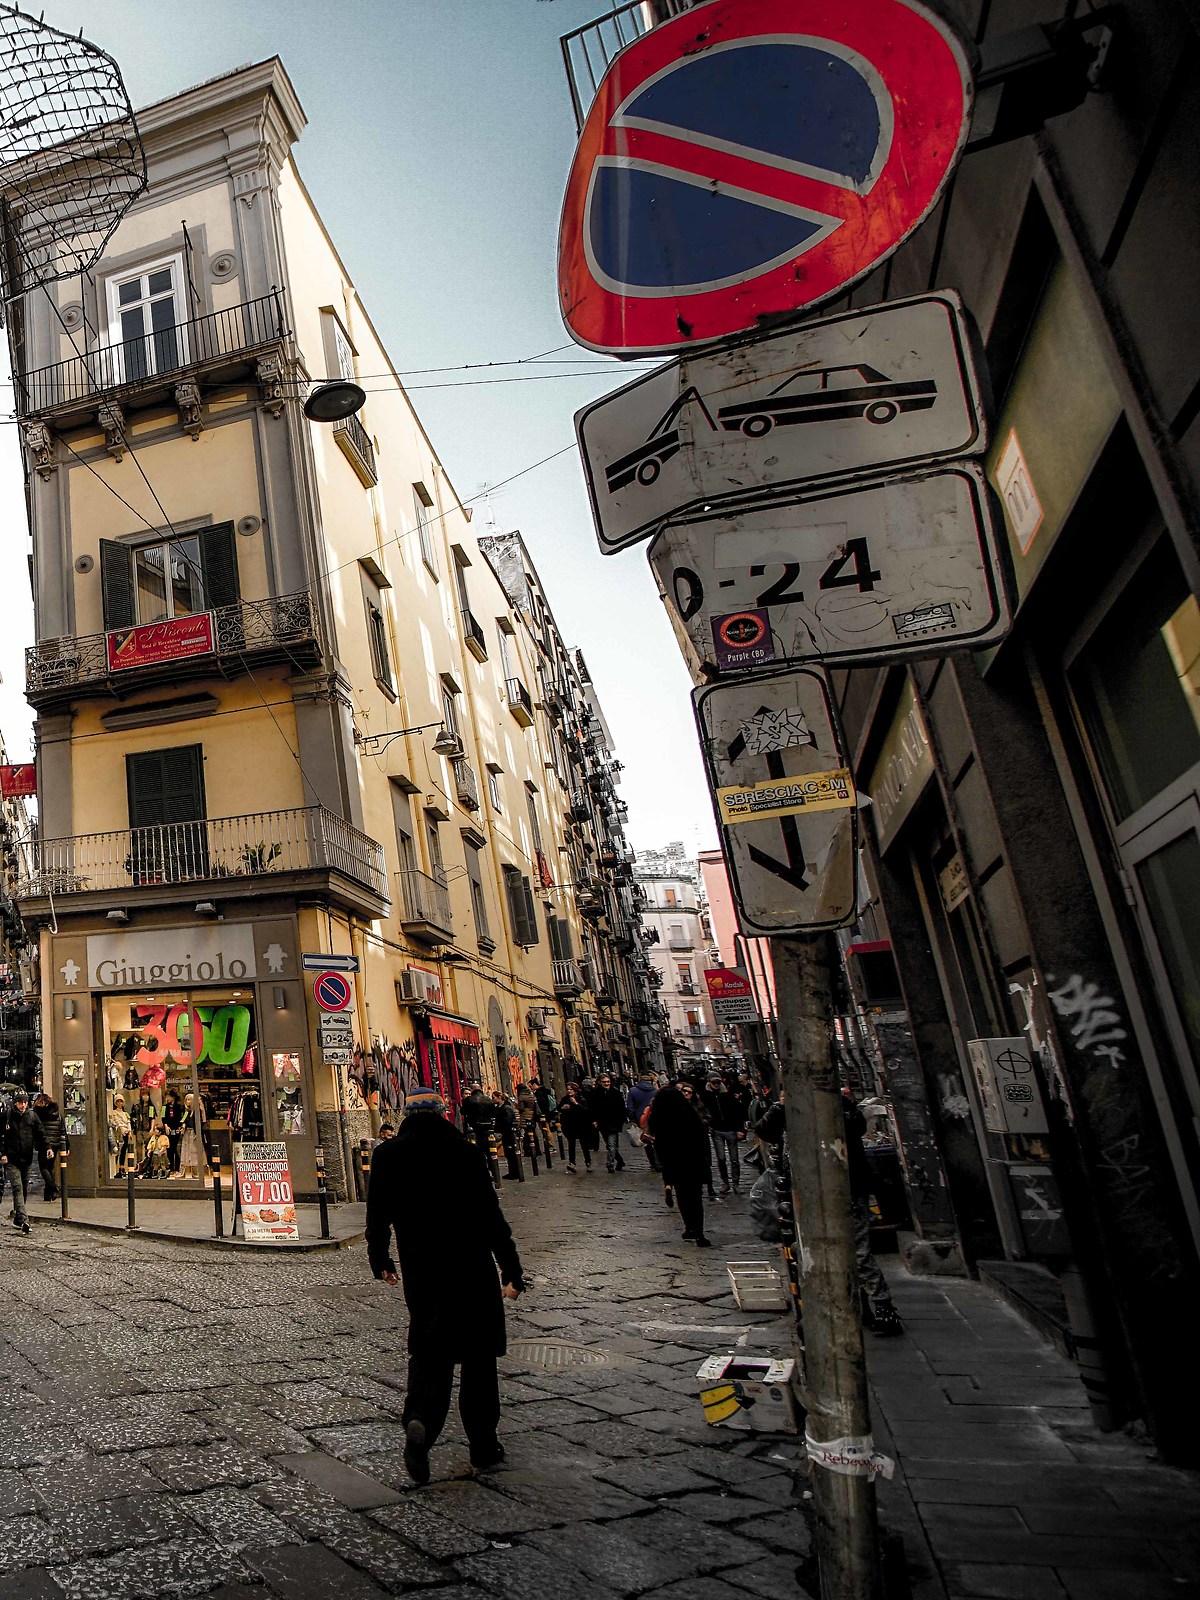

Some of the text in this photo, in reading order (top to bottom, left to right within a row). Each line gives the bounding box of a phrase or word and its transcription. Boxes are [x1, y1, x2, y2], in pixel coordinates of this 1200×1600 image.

[158, 620, 206, 639] Visconti
[727, 652, 750, 663] Purple
[751, 649, 765, 659] CBD
[728, 805, 748, 814] Photo
[750, 801, 782, 811] Specialist
[784, 798, 803, 807] Store
[95, 952, 247, 987] Giuggiolo
[242, 1182, 291, 1203] € 7.00
